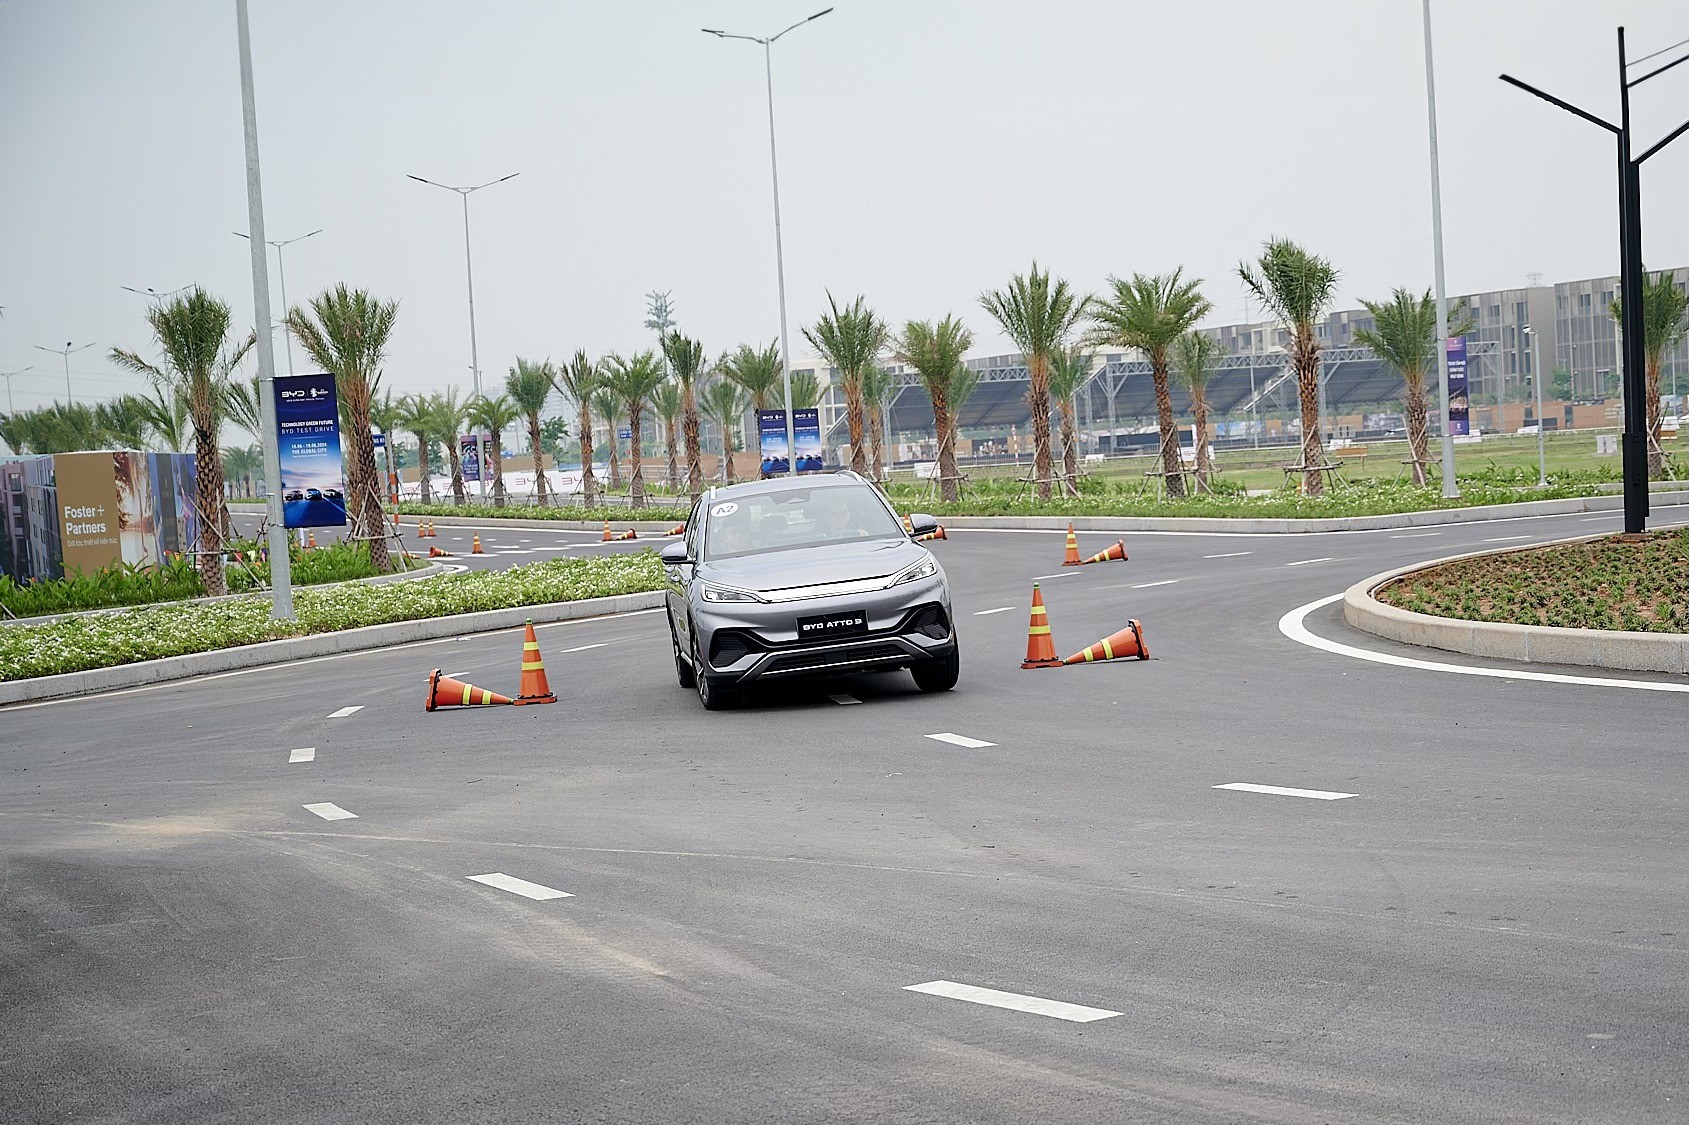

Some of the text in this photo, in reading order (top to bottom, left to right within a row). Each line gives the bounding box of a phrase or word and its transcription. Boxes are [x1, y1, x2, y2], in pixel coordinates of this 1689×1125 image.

[281, 390, 305, 398] BYD
[64, 504, 105, 519] Foster +
[716, 505, 734, 515] A2
[65, 522, 106, 535] Partners
[803, 622, 824, 631] BYD
[826, 620, 853, 628] ATTO
